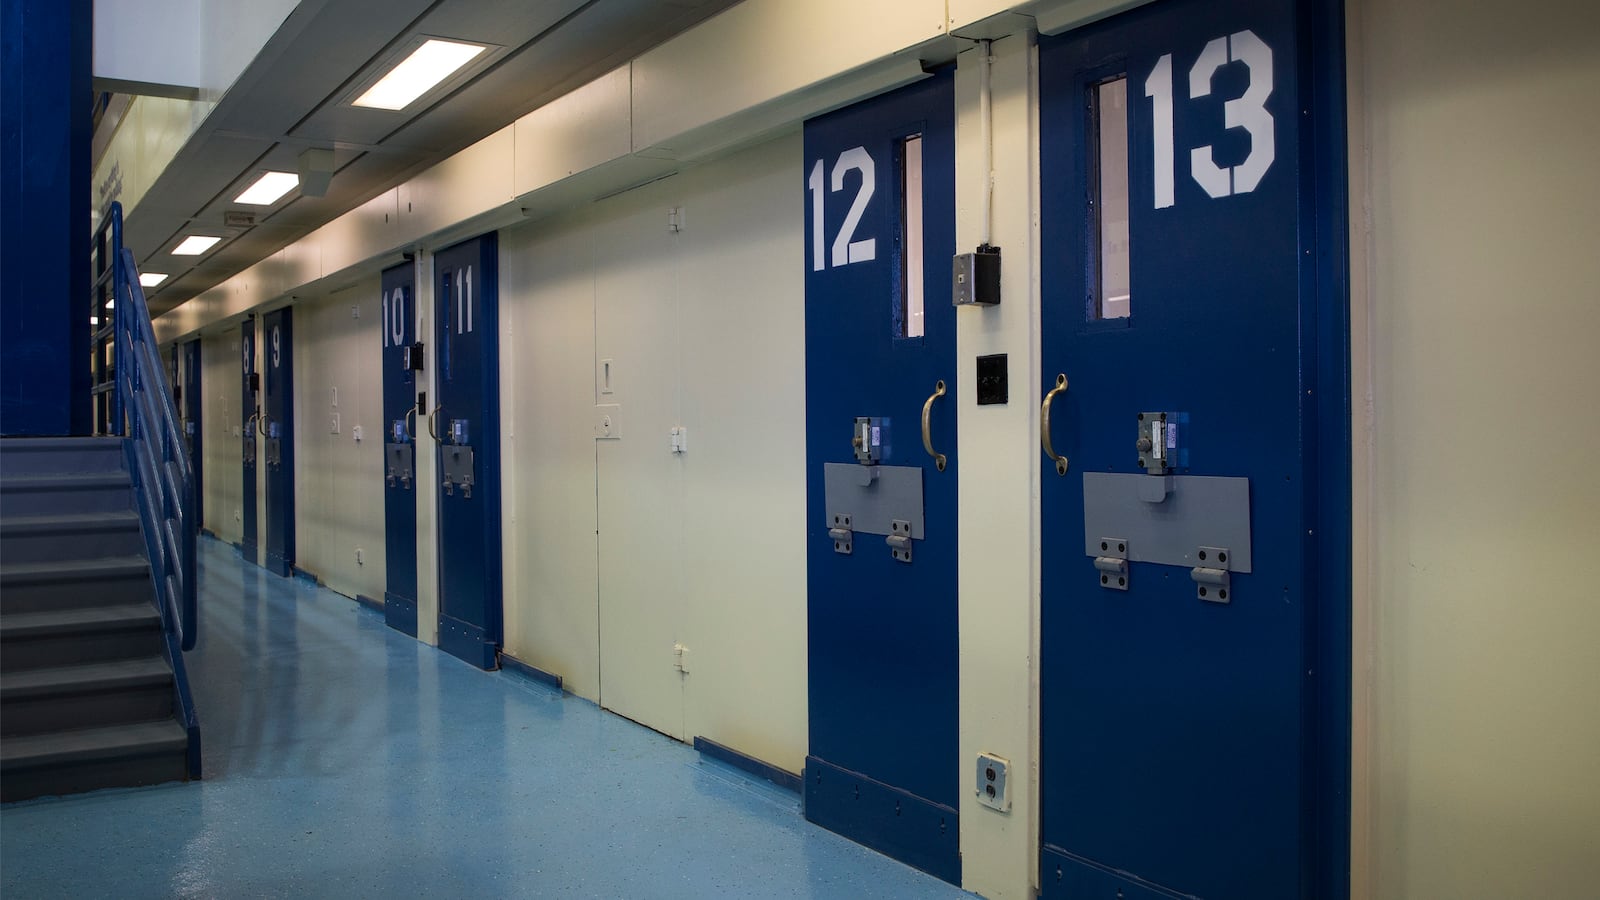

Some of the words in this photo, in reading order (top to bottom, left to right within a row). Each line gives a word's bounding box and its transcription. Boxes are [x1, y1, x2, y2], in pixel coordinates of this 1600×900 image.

[1145, 30, 1275, 209] 13
[809, 146, 876, 271] 12
[383, 287, 404, 347] 10
[456, 265, 473, 334] 11
[243, 336, 250, 374] 8
[273, 326, 280, 368] 9
